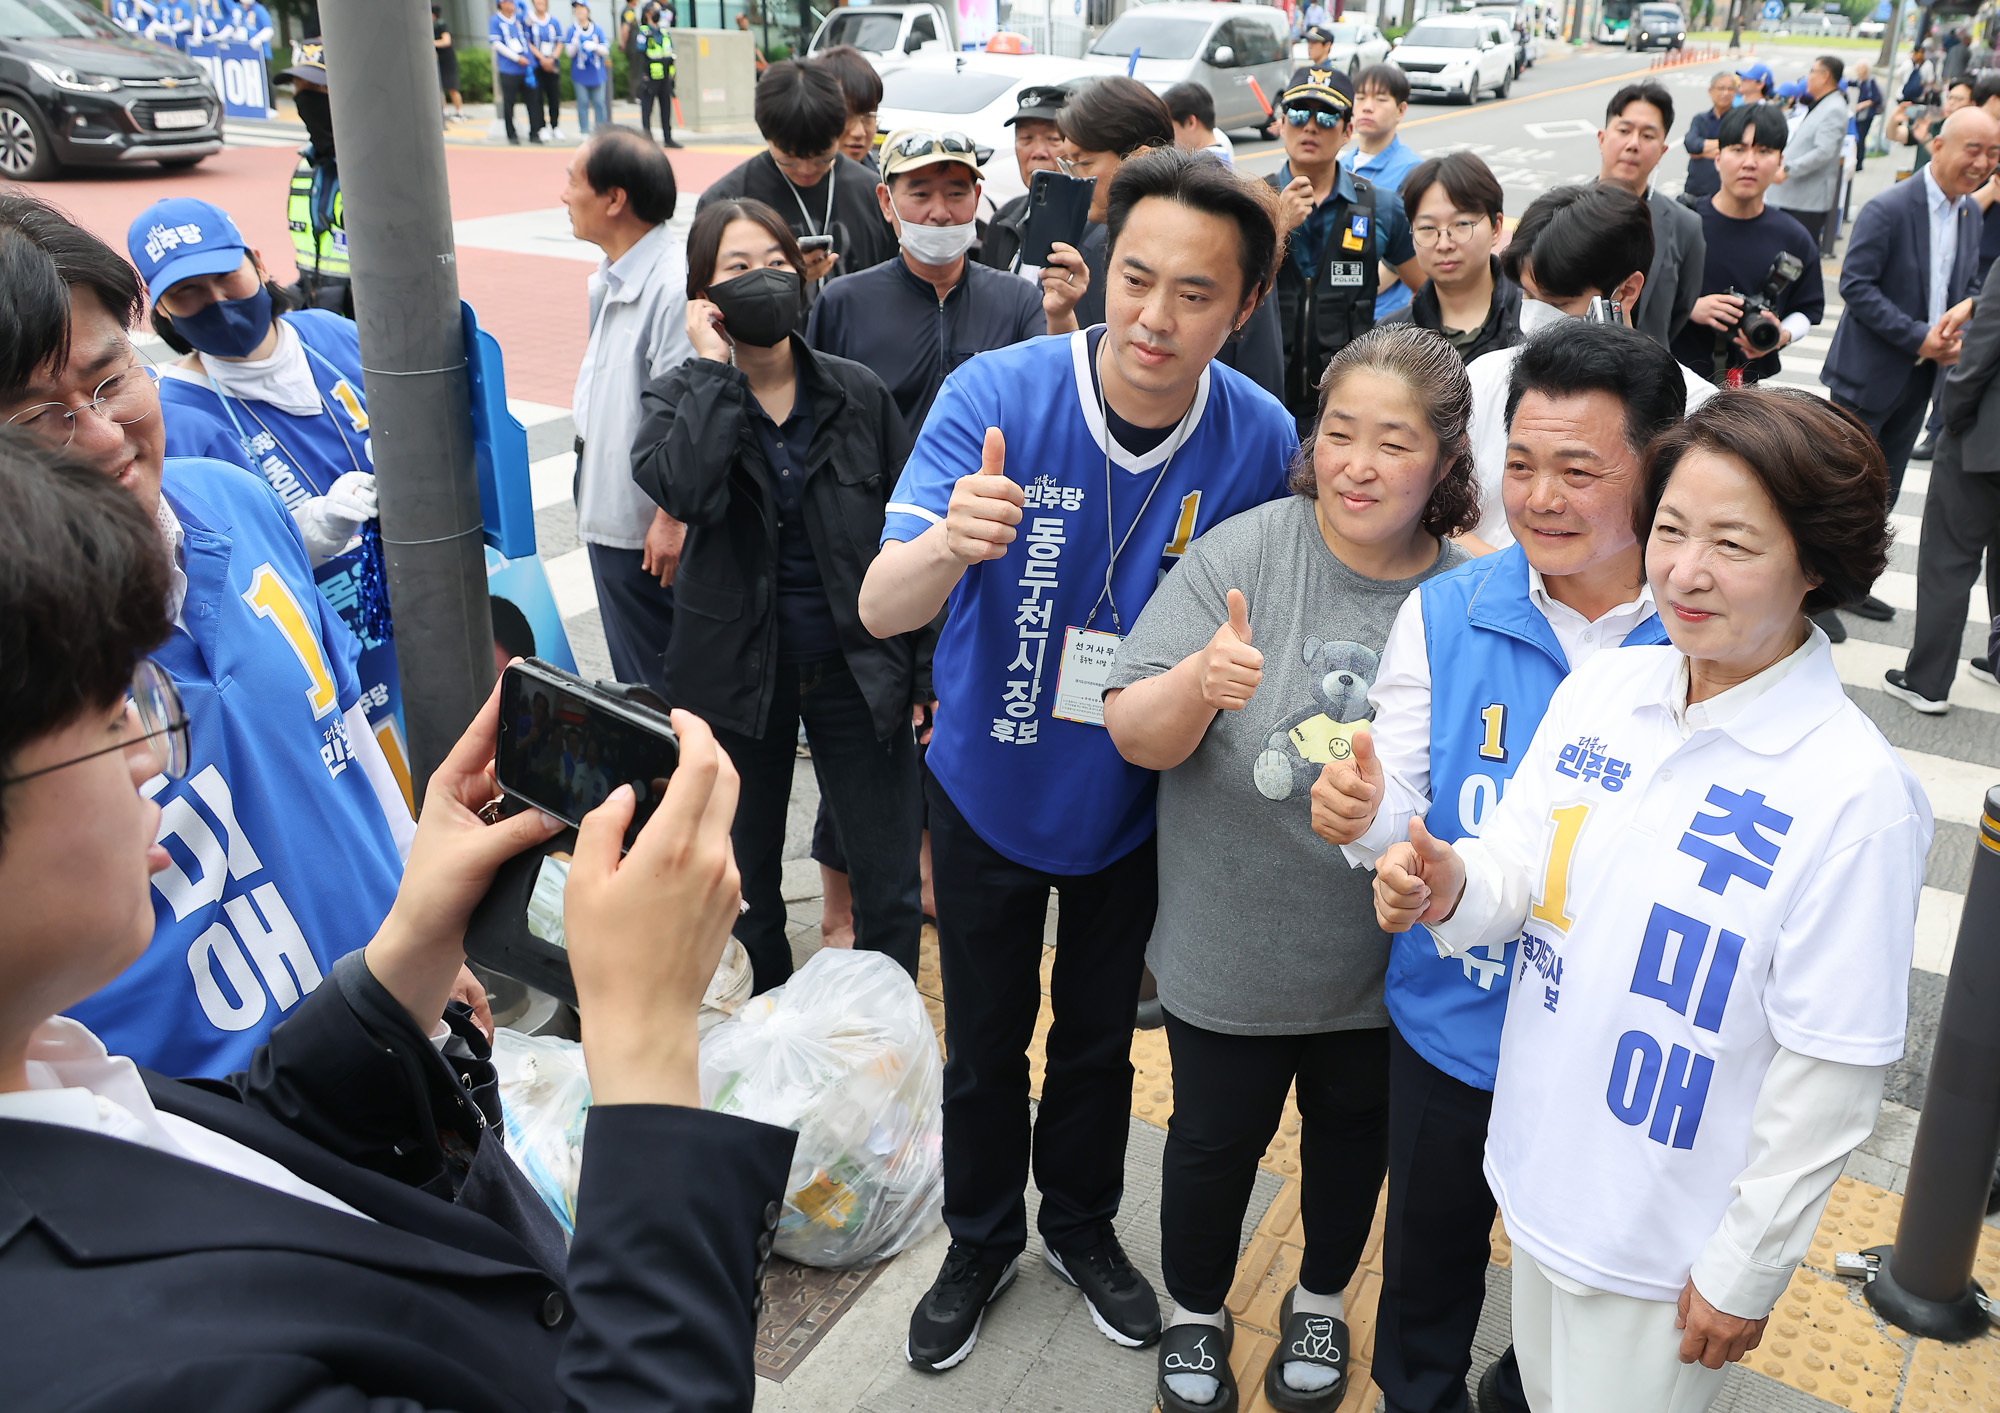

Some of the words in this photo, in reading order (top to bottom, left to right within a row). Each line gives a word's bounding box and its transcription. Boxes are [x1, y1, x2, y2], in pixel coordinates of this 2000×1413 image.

[144, 223, 203, 264] 민주당
[1354, 217, 1365, 235] 4
[1333, 263, 1361, 276] 경찰
[329, 379, 370, 434] 1
[1022, 484, 1085, 512] 민주당
[1034, 473, 1057, 488] 더불어
[1161, 489, 1203, 558] 1
[241, 562, 339, 722] 1
[989, 717, 1040, 745] 후보
[1478, 702, 1509, 765] 1
[1578, 736, 1608, 755] 더불어
[1555, 743, 1632, 793] 민주당
[1528, 797, 1599, 940] 1
[1606, 783, 1794, 1151] 추미애
